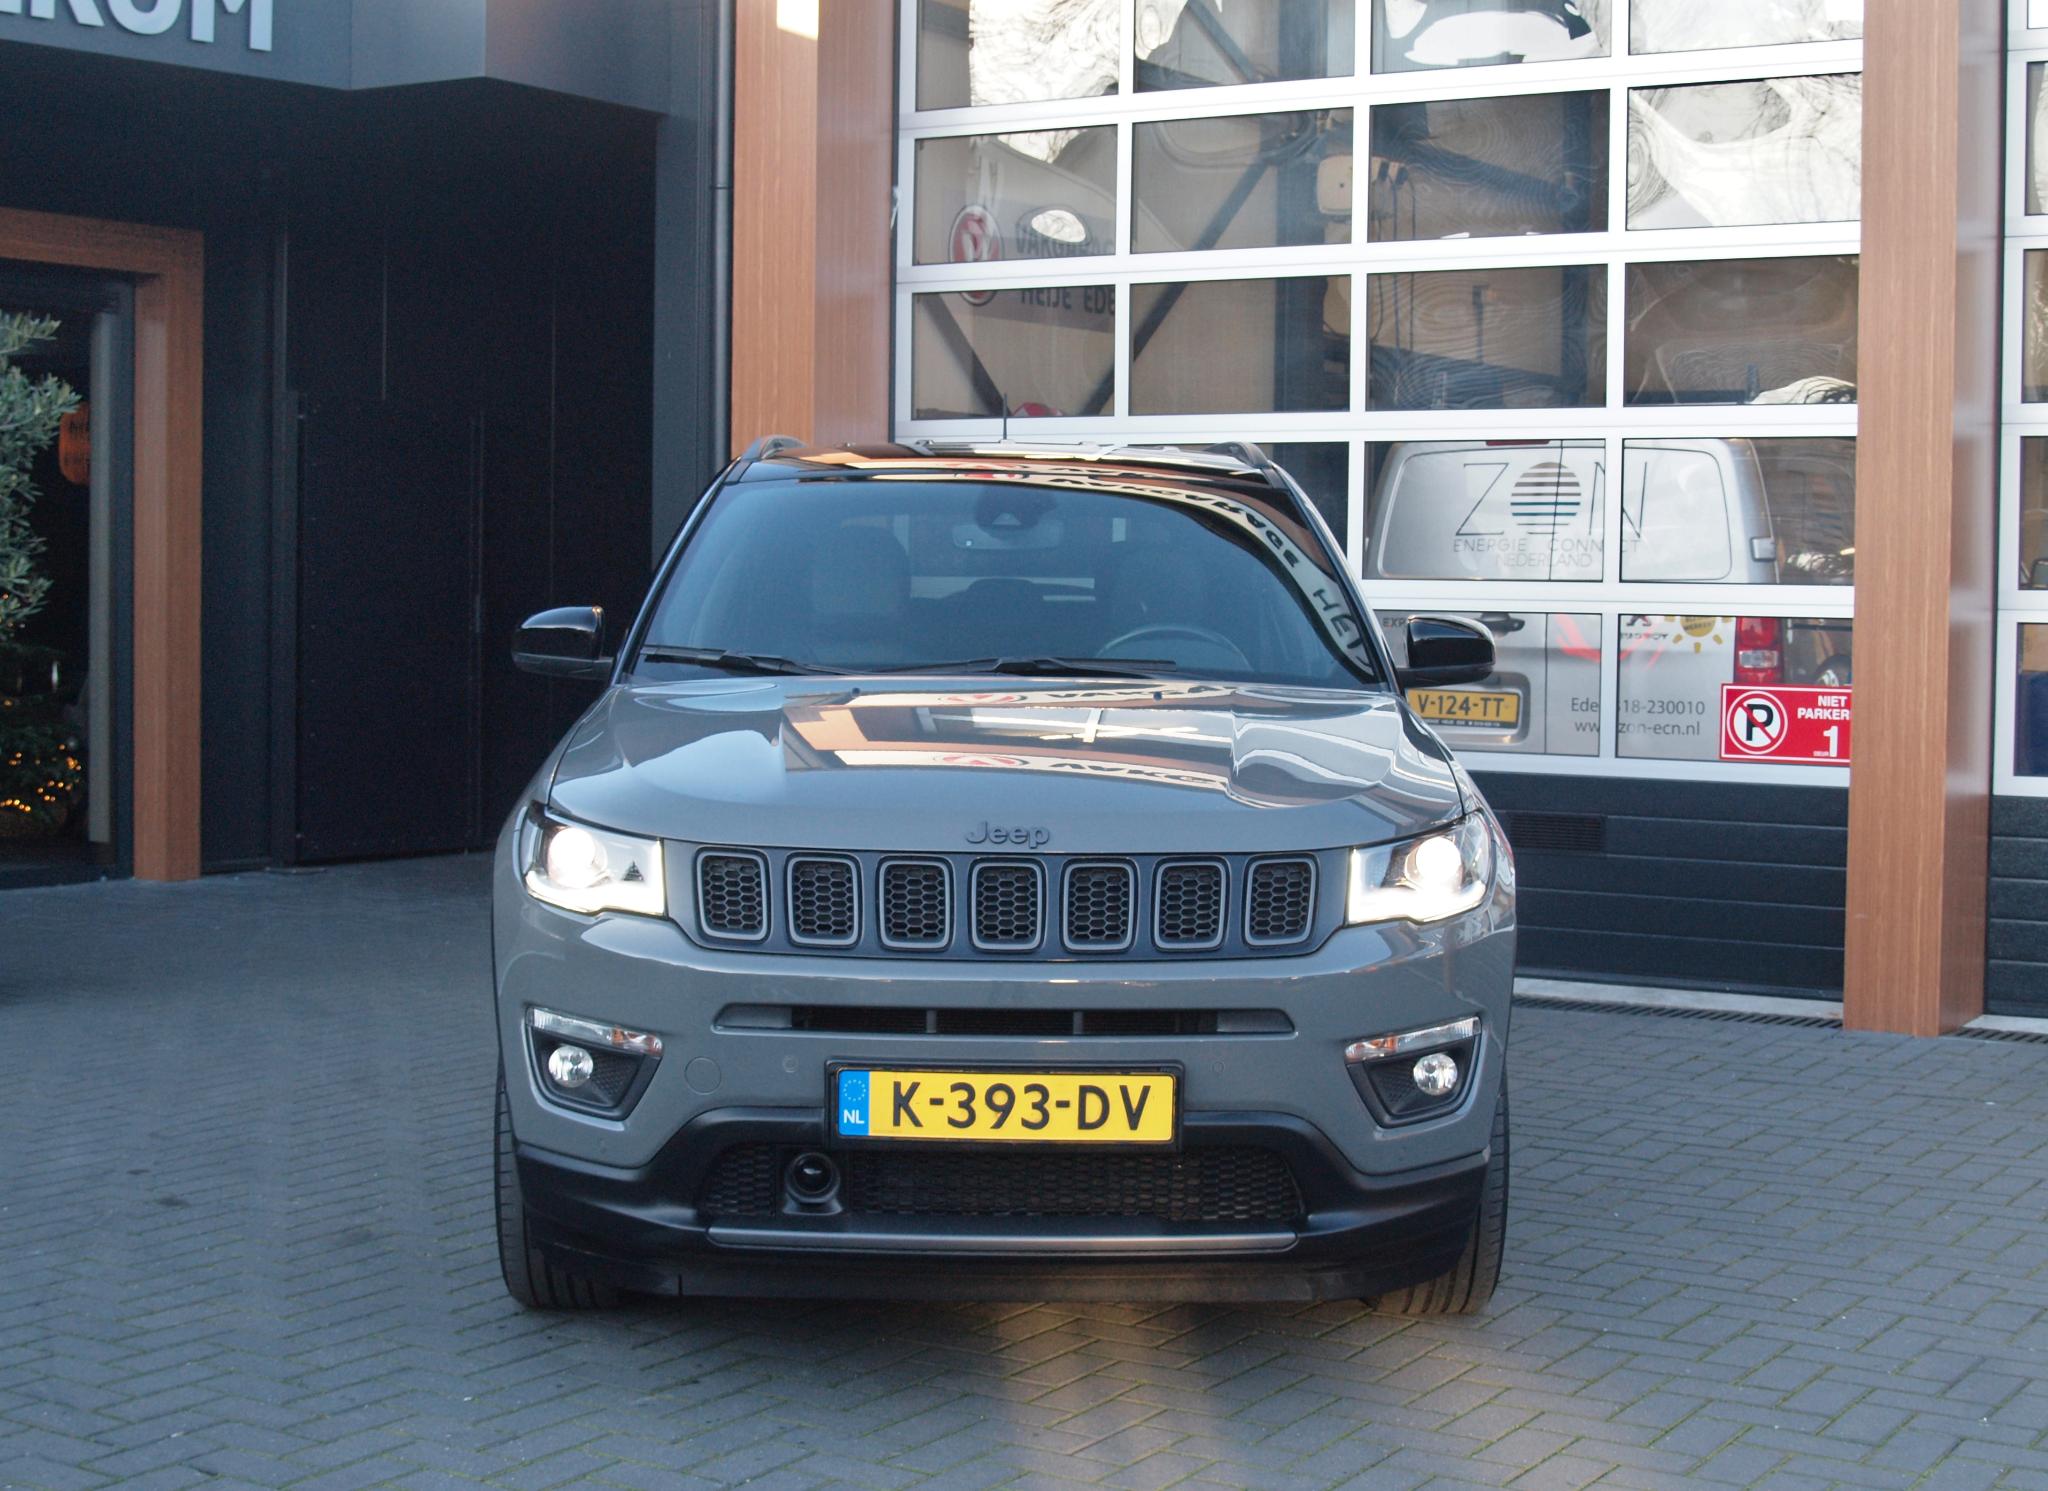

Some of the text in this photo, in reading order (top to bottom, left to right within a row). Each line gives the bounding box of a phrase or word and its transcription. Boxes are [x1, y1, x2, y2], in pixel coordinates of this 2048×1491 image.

[1453, 538, 1528, 553] ENERGIE
[1496, 553, 1593, 568] NEDERLAND
[1417, 694, 1504, 718] V-124-TT
[1571, 697, 1598, 712] Ede
[1817, 695, 1848, 707] NIET
[1823, 726, 1839, 757] 1
[966, 821, 1050, 849] Jeep
[843, 1080, 1152, 1131] NL K-393-DV
